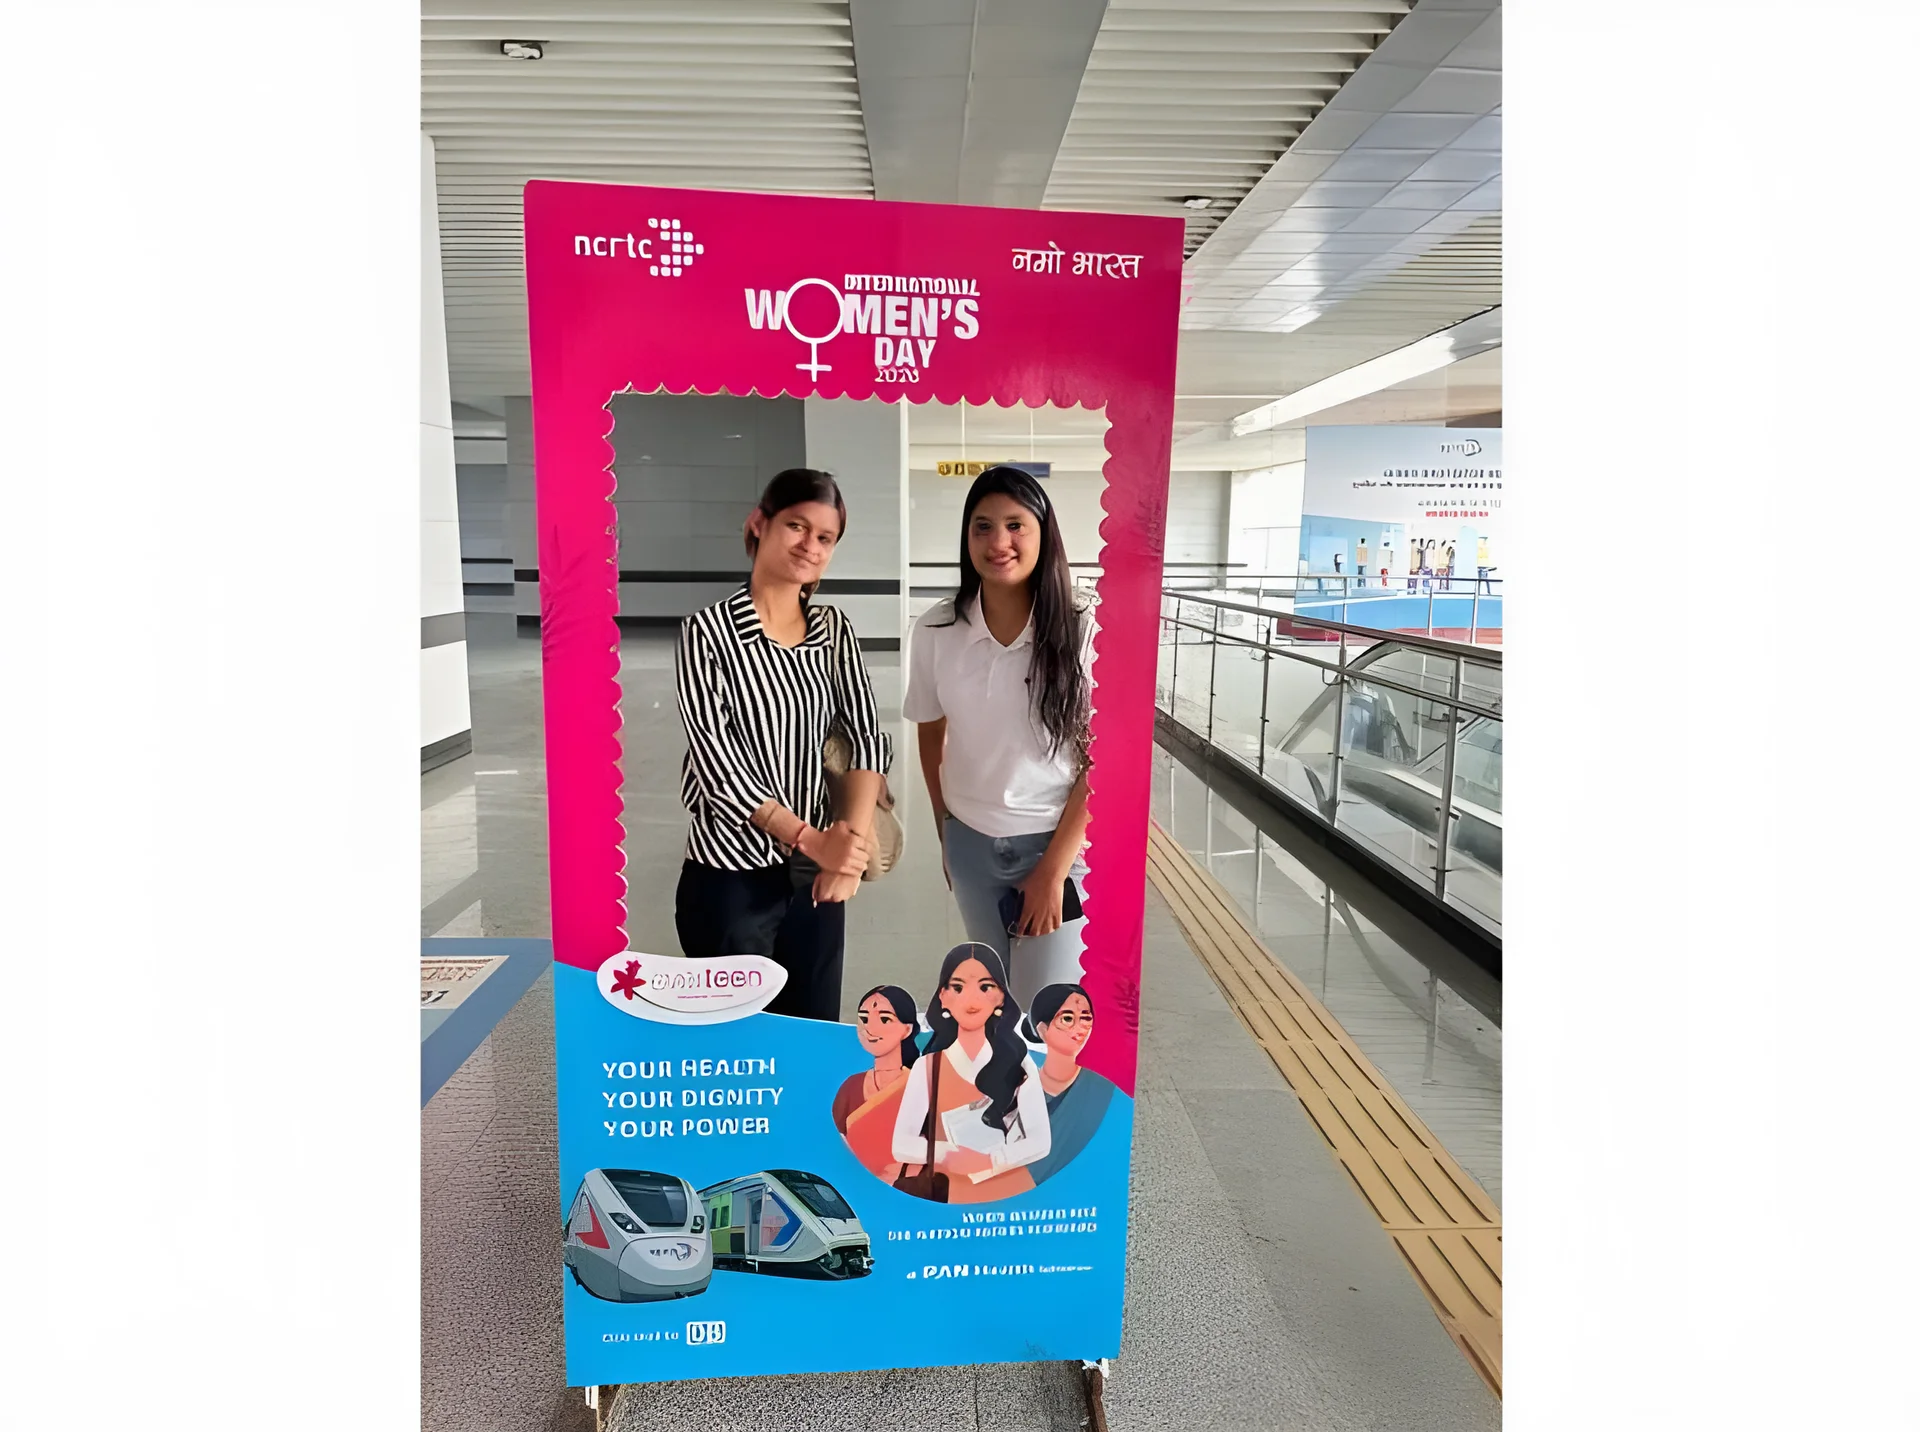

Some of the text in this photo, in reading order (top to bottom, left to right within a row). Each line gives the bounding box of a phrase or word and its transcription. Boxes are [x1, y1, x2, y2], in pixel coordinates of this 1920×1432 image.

[574, 233, 653, 259] ncrtc
[1011, 240, 1145, 280] नमो भारत
[744, 278, 981, 346] WOMEN'S
[874, 337, 937, 369] DAY
[602, 1057, 776, 1079] YOUR HEALTH
[602, 1087, 784, 1109] YOUR DIGNITY
[603, 1117, 770, 1138] YOUR POWER
